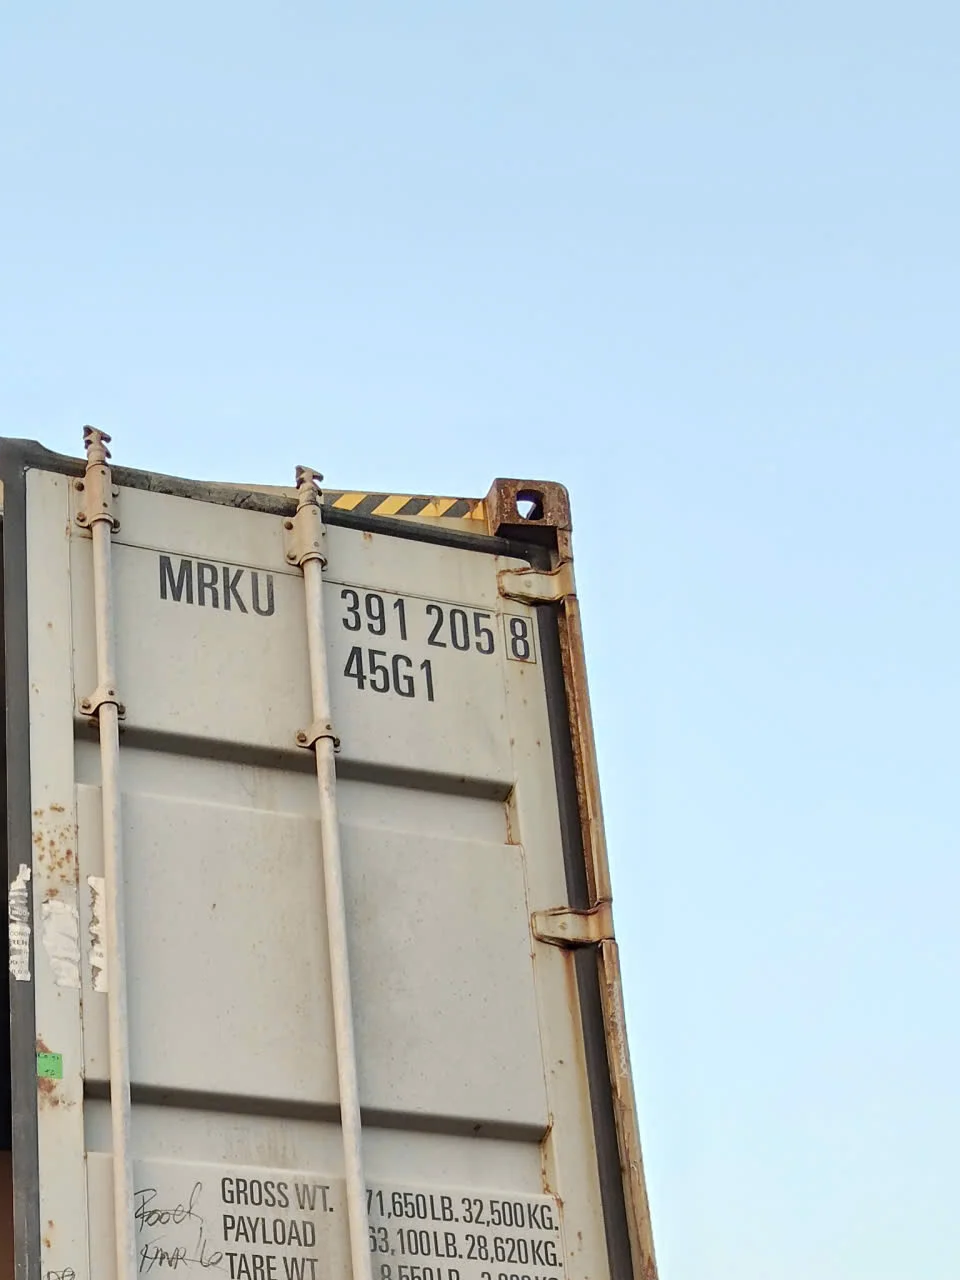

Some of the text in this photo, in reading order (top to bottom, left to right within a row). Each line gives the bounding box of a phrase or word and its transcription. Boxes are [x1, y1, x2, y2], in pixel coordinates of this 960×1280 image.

[159, 554, 530, 660] MRKU 391 205 8
[343, 645, 435, 702] 45G1
[221, 1176, 289, 1208] GROSS
[294, 1183, 334, 1212] WT.
[223, 1214, 316, 1248] PAYLOAD
